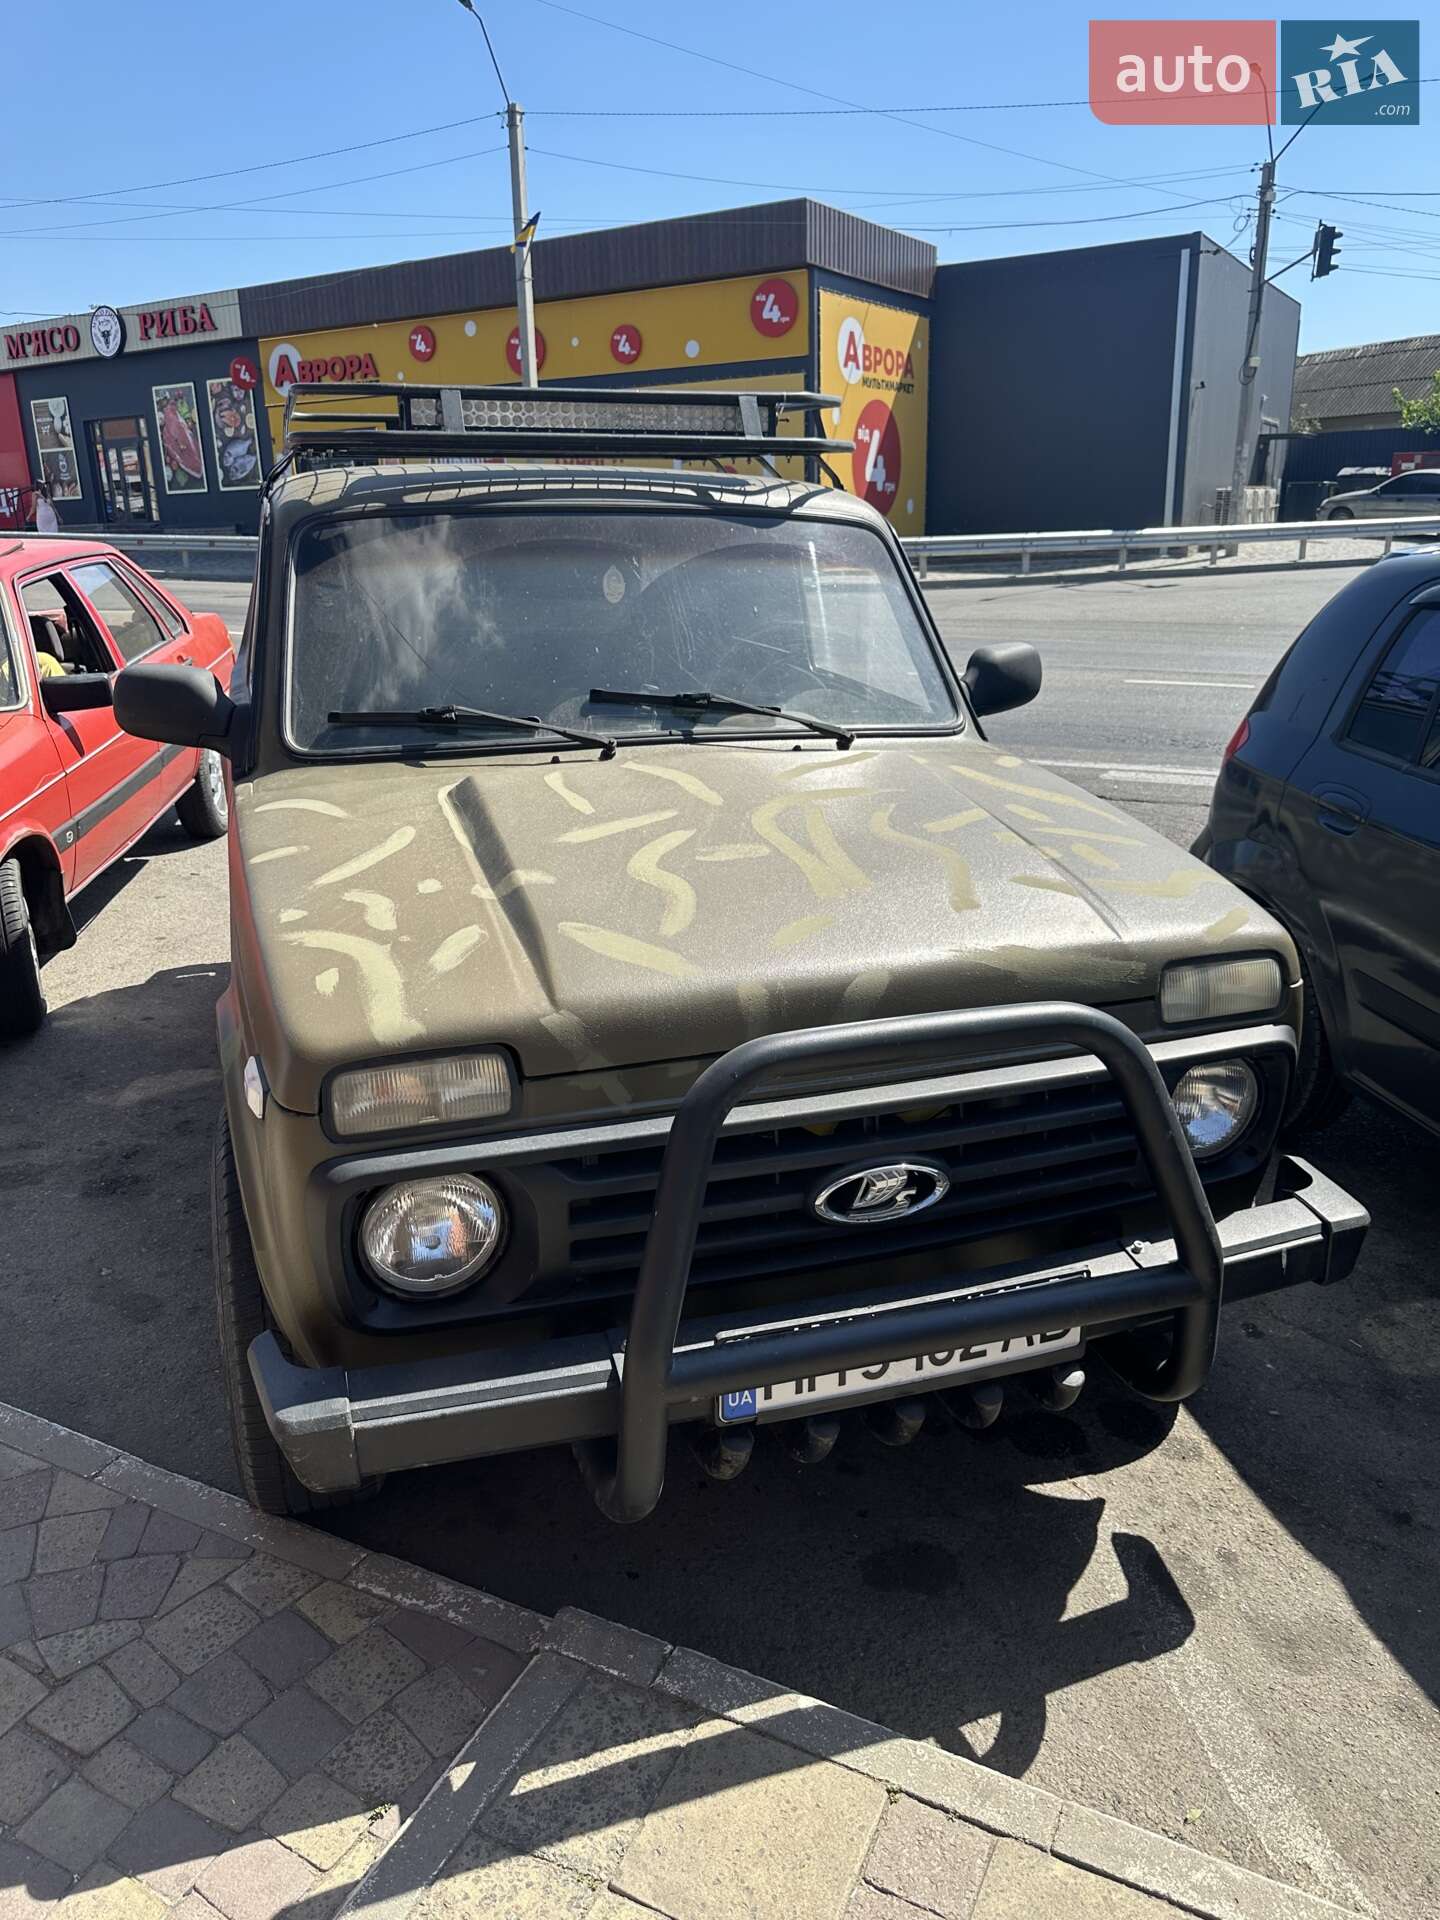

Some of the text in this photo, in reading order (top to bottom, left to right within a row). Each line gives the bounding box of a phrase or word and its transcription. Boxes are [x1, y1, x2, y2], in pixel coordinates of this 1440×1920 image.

[762, 293, 781, 323] 4
[137, 302, 219, 341] РИБА
[415, 333, 427, 353] 4
[618, 333, 631, 356] 4
[239, 364, 251, 383] 4
[865, 428, 887, 492] 4
[728, 1390, 753, 1407] UA
